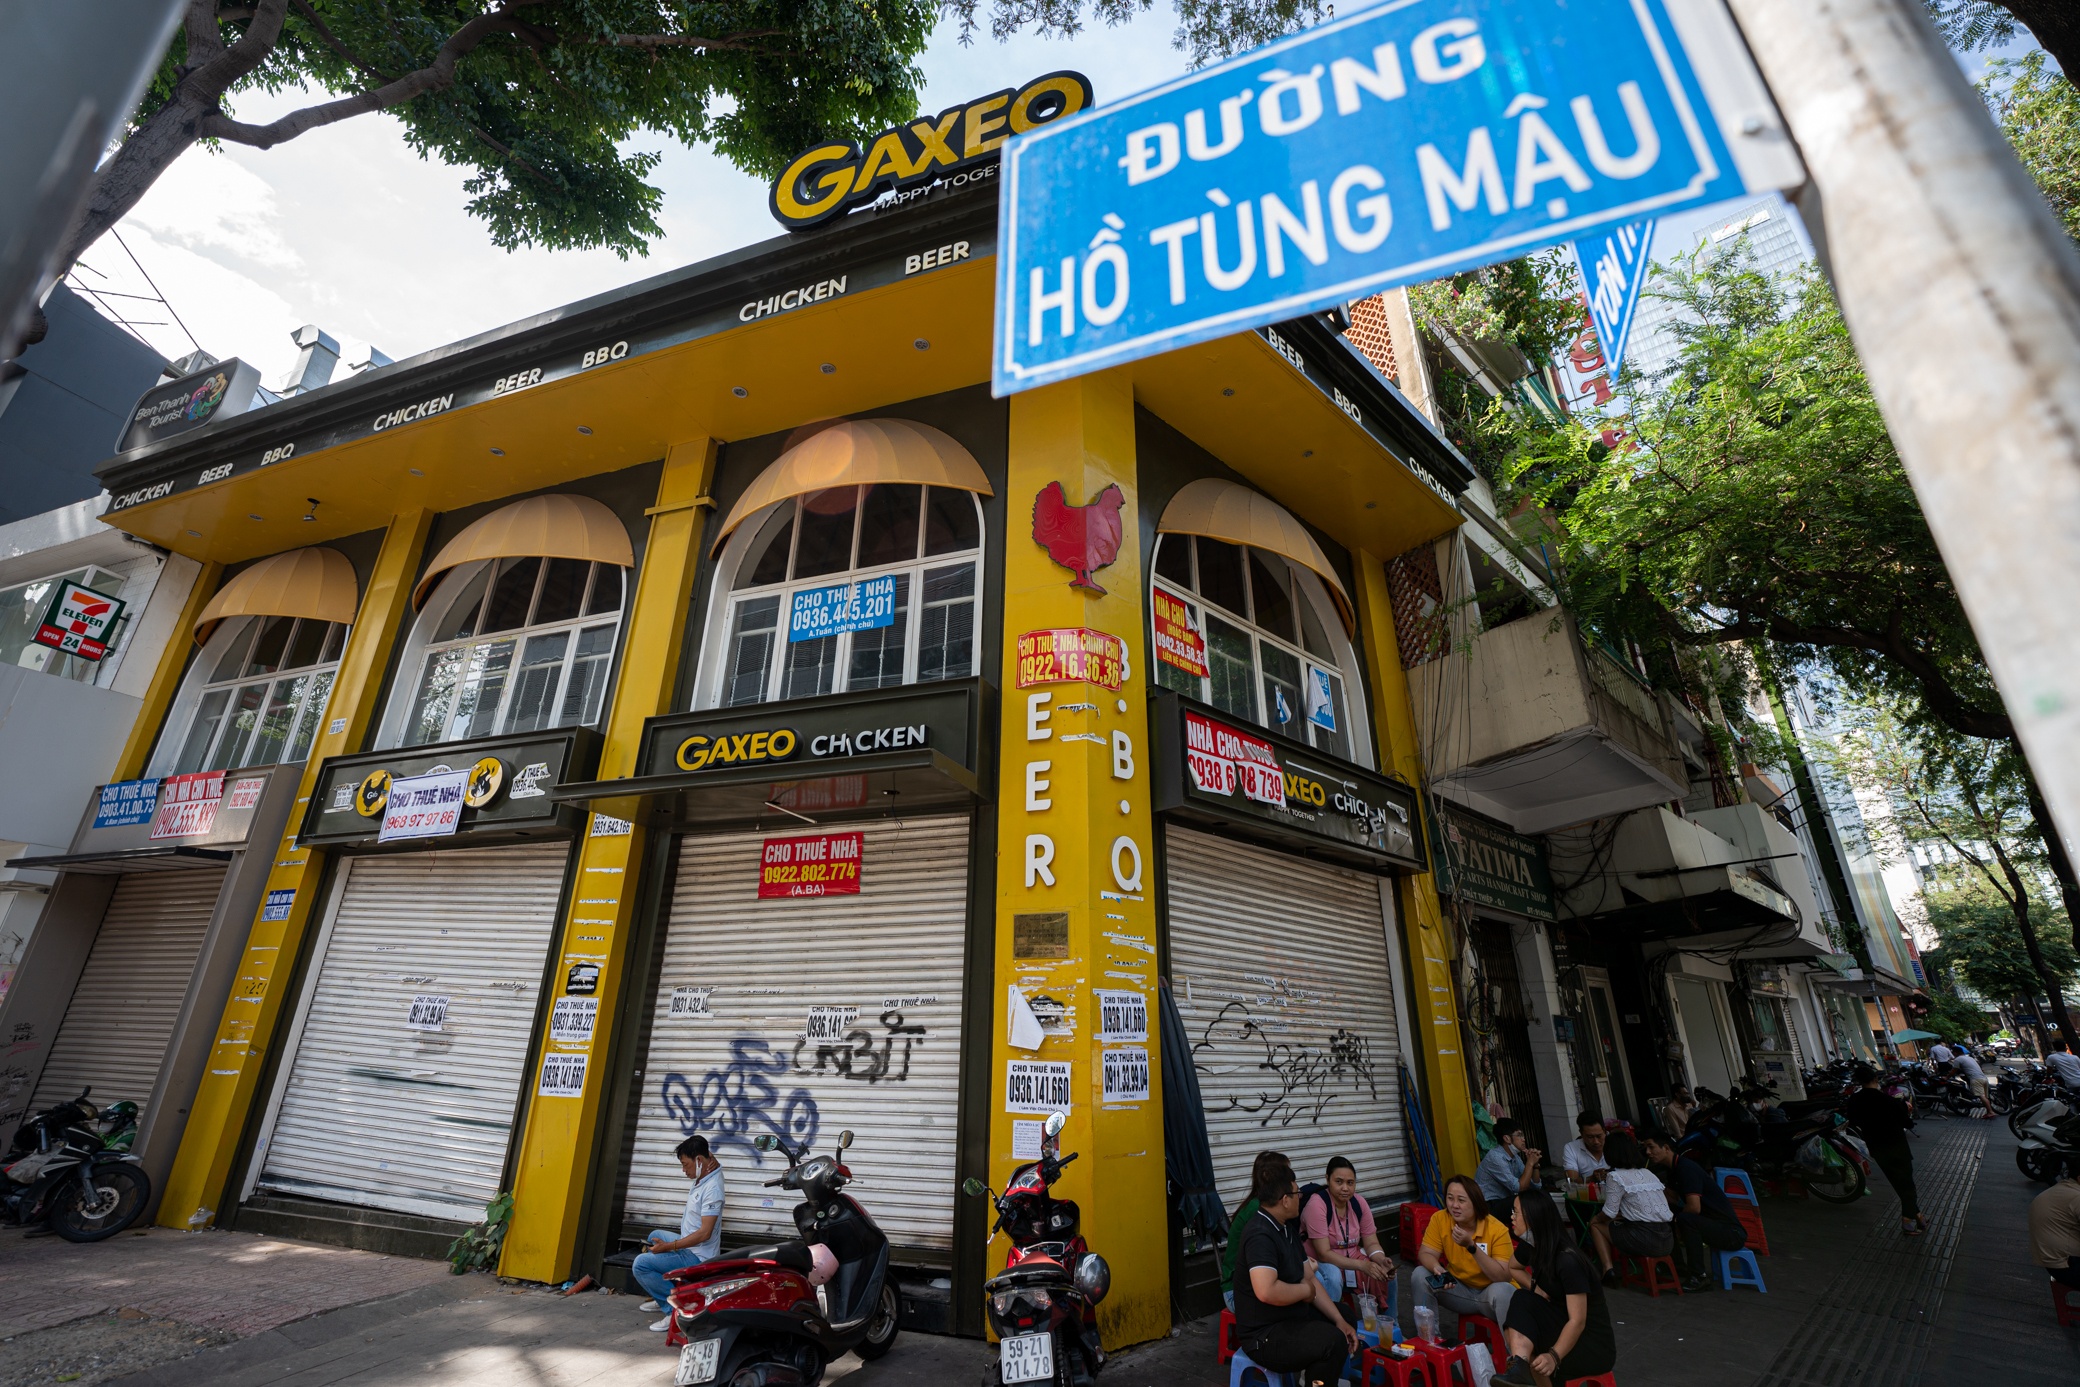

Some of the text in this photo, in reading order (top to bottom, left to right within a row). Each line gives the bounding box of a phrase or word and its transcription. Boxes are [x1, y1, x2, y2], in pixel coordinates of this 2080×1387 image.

[1119, 17, 1486, 188] ĐƯỜNG
[775, 75, 1084, 220] GAXEO
[872, 185, 933, 211] HAPPY
[1029, 80, 1661, 346] HỒ TÙNG MẬU
[113, 240, 970, 509] CHICKEN BEER BBQ CHICKEN BEER BBQ CHICKEN BEER
[149, 406, 184, 428] Tourist
[1268, 326, 1456, 509] BEER BBQ CHICKEN
[794, 575, 894, 610] CHO THUÊ NHÀ
[793, 594, 892, 632] 0936.445.201
[1156, 595, 1185, 628] NHÀ CHO
[42, 630, 102, 655] OPEN 24 HOURS
[1021, 637, 1034, 657] CHO
[1037, 632, 1058, 654] THUÊ
[1060, 631, 1078, 652] NHÀ
[1020, 653, 1119, 687] 0922.16.36.36
[676, 724, 925, 771] GAXEO CHICKEN
[1187, 720, 1215, 753] NHÀ
[1216, 730, 1245, 760] CHO
[102, 778, 160, 802] CHO THUÊ NHÀ
[191, 779, 204, 800] CHO
[205, 772, 225, 798] THUÊ
[1188, 754, 1223, 791] 0938
[1259, 768, 1281, 802] 739
[98, 799, 155, 818] 0903.41.00.73
[389, 792, 411, 810] CHO
[411, 785, 439, 807] THUÊ
[439, 783, 461, 803] NHÀ
[408, 814, 425, 827] 97
[425, 812, 440, 826] 97
[440, 810, 455, 825] 86
[1292, 809, 1316, 822] TOGETHER
[765, 835, 858, 863] CHO THUÊ NHÀ
[1456, 834, 1535, 888] FATIMA
[764, 862, 855, 883] 0922.802.774
[791, 884, 825, 897] (A.BA)
[1466, 871, 1547, 904] ARTS HANDICRAFT SHOP
[556, 998, 597, 1010] CHO THUÊ NHÀ
[884, 999, 899, 1008] CHO
[900, 997, 919, 1007] THUÊ
[1104, 995, 1142, 1004] CHO THUÊ NHÀ
[807, 1015, 857, 1038] 0936.141
[1103, 1006, 1146, 1033] 0936.141.660
[559, 1054, 572, 1064] THUÊ
[573, 1056, 585, 1064] NHÀ
[1012, 1064, 1066, 1074] CHO THUÊ NHÀ
[1105, 1051, 1147, 1063] CHO THUÊ NHÀ
[542, 1065, 585, 1089] 0936.141.660
[1009, 1074, 1069, 1106] 0936.141.660
[686, 1342, 714, 1363] 54-X8
[1009, 1337, 1042, 1358] 59-Z1
[681, 1361, 711, 1382] 7467
[1005, 1356, 1050, 1380] 214.78
